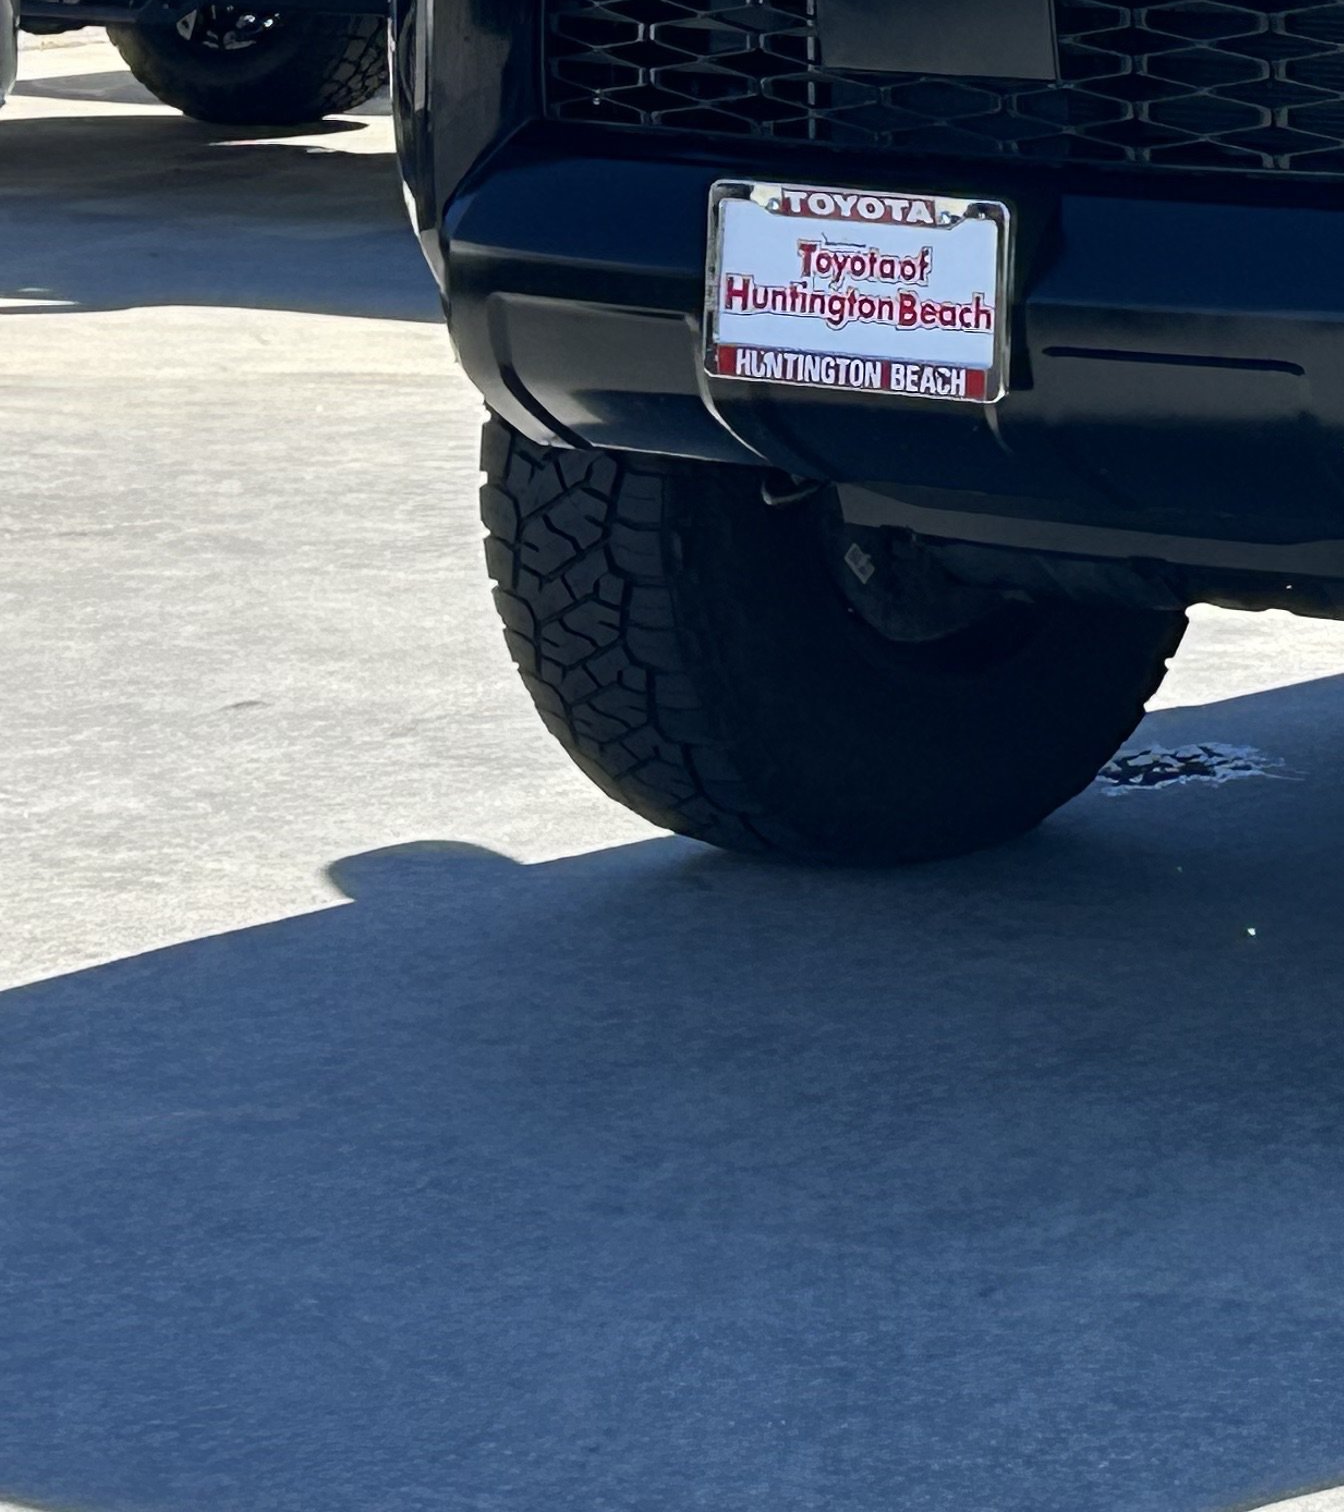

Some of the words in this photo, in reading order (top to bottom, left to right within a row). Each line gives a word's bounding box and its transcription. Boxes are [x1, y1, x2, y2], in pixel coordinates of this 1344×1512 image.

[784, 192, 934, 224] TOYOTA
[799, 242, 895, 283] Toyota
[898, 248, 931, 281] of
[725, 276, 894, 326] Huntington
[898, 291, 992, 329] Beach
[735, 349, 882, 388] HUNTINGTON
[890, 364, 967, 396] BEACH
